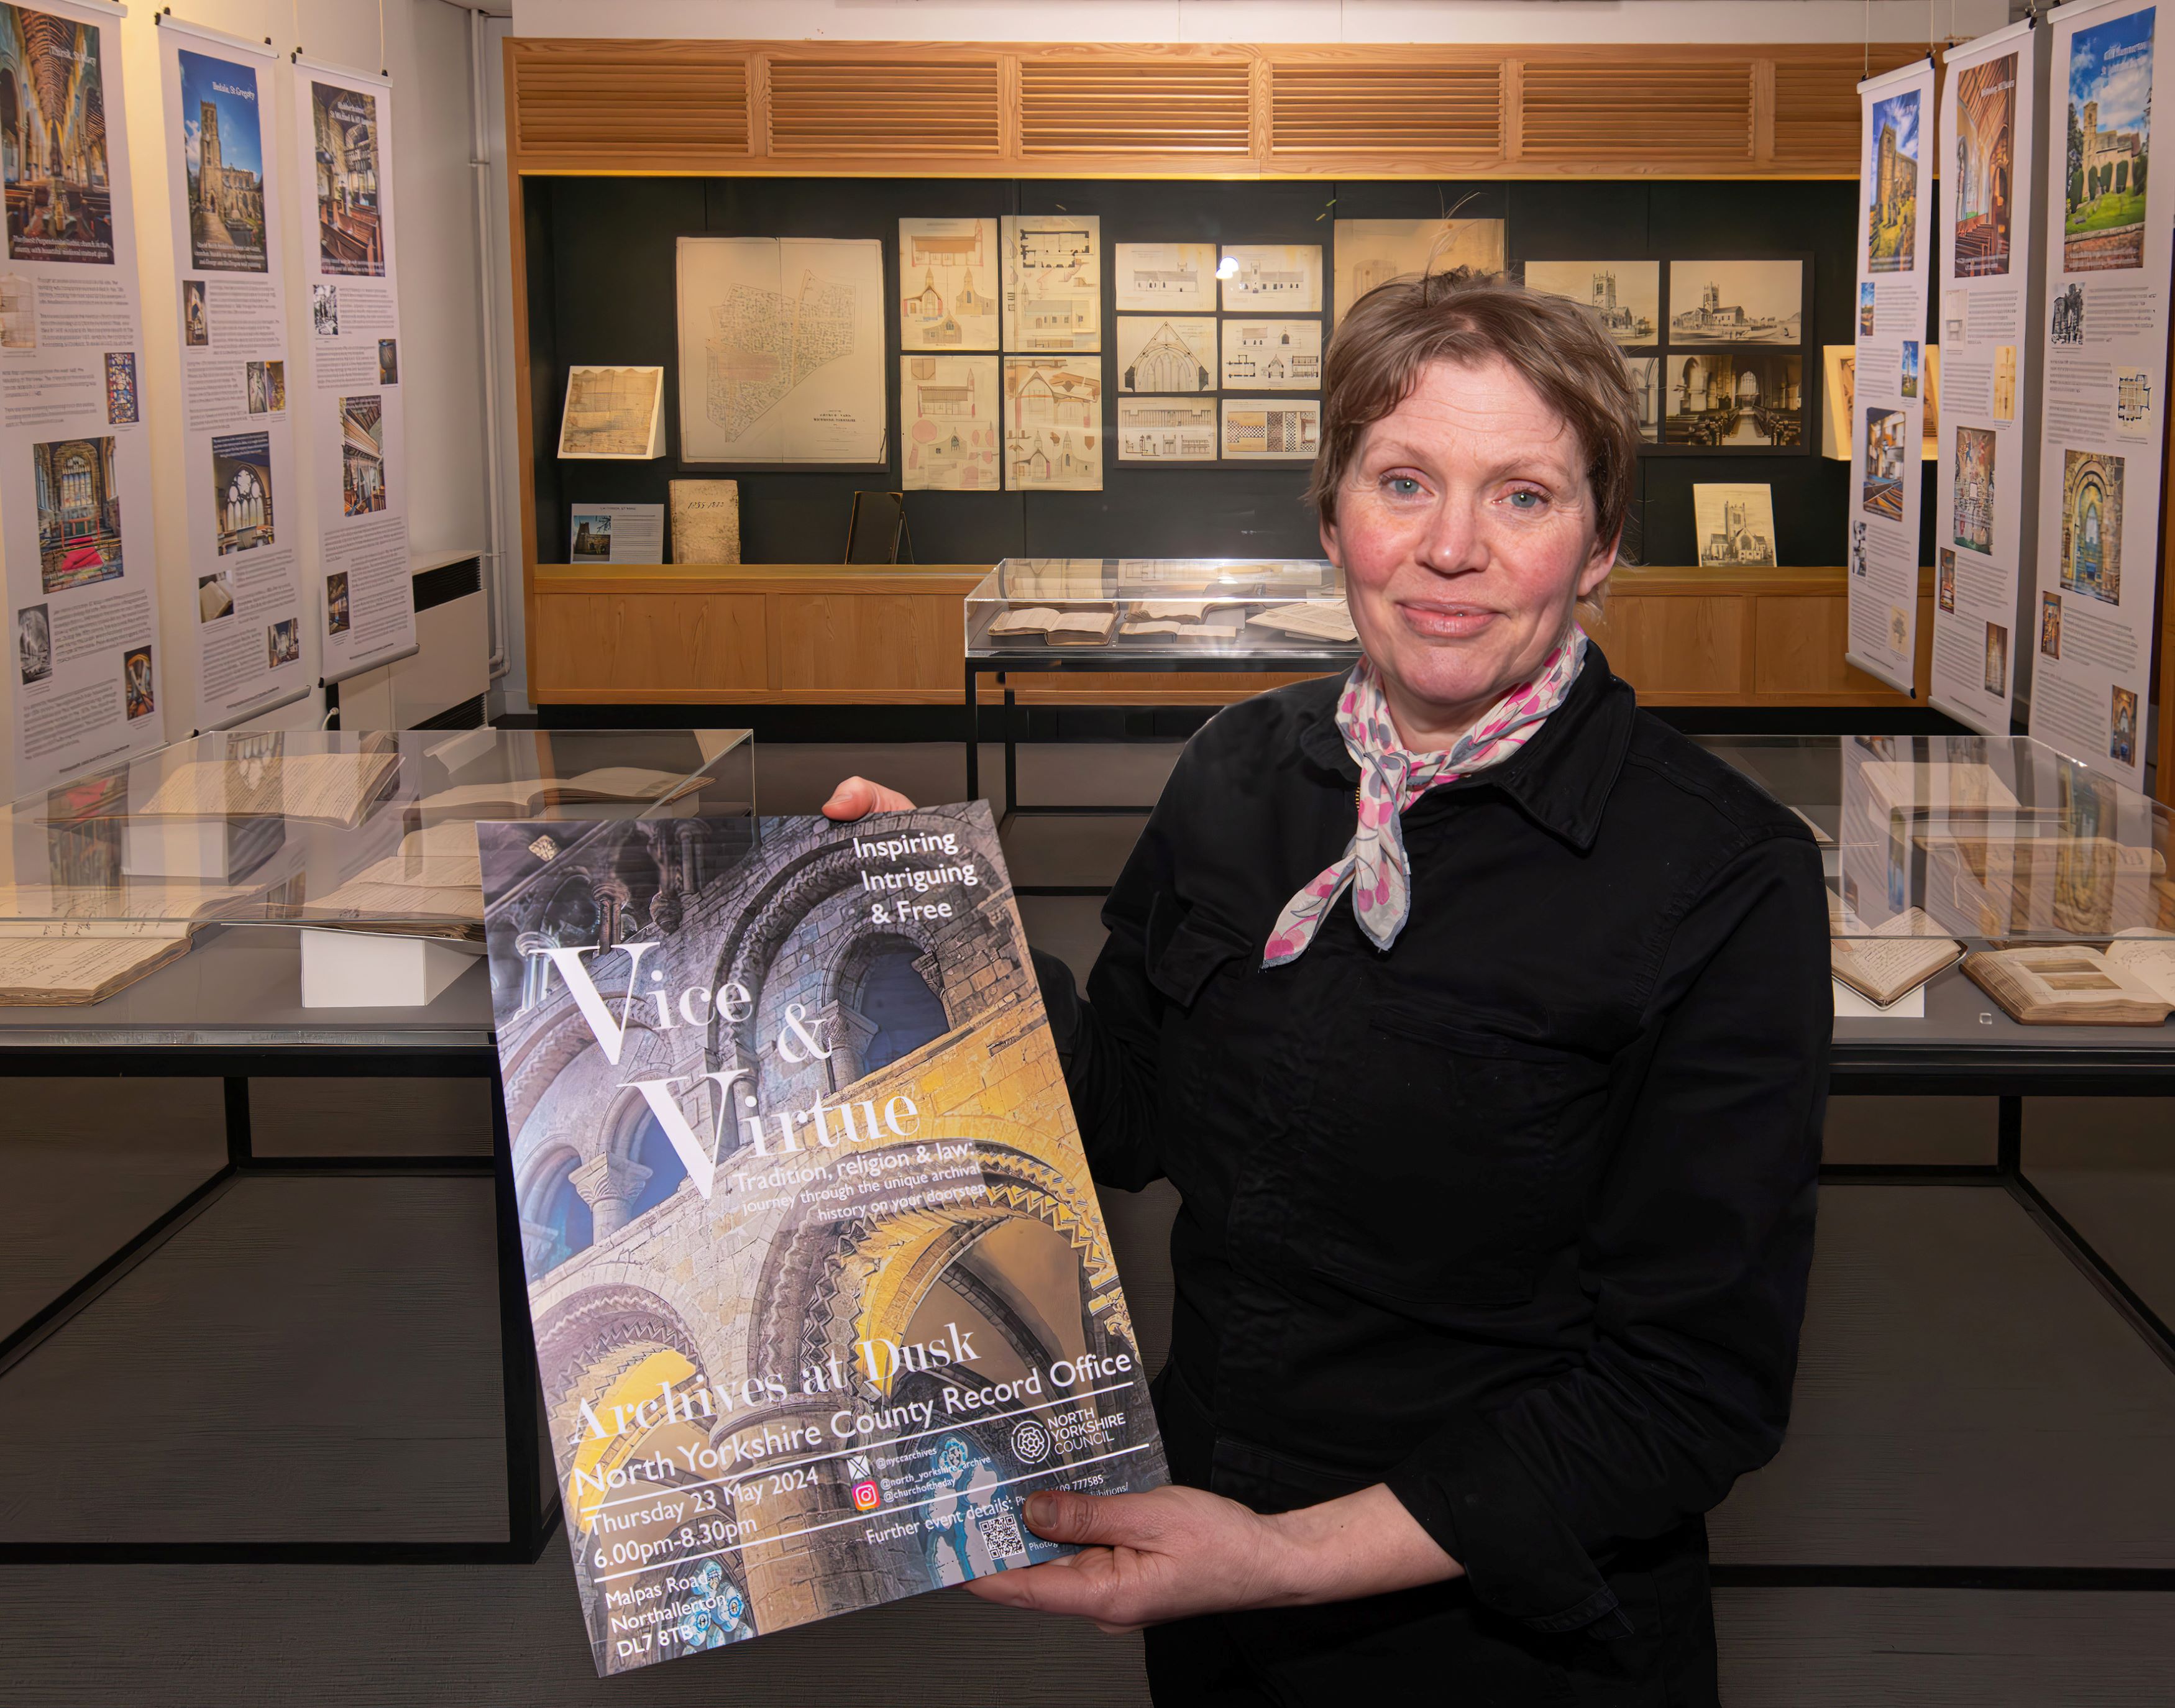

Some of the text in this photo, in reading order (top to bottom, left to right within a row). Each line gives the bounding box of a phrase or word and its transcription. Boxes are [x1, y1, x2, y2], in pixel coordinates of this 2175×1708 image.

[853, 832, 959, 862] Inspiring
[861, 863, 978, 892] Intriguing
[871, 900, 953, 925] & Free
[528, 941, 753, 1066] Vice
[777, 1002, 833, 1064] &
[615, 1068, 921, 1200] Virtue
[731, 1141, 976, 1193] Tradition, religion & law:
[742, 1161, 981, 1217] journey through the unique archival
[817, 1184, 987, 1222] history on your doorstep
[567, 1322, 982, 1445] Archives at Dusk
[573, 1352, 1132, 1497] North Yorkshire County Record Office
[1047, 1407, 1095, 1430] NORTH
[1050, 1412, 1126, 1442] YORKSHIRE
[876, 1447, 937, 1470] @nyccarchives
[1054, 1430, 1115, 1455] COUNCIL
[880, 1455, 992, 1491] @north_yorkshire_archive
[883, 1477, 956, 1503] @churchoftheday
[1072, 1474, 1104, 1491] 777585
[585, 1466, 819, 1536] Thursday 23 May 2024
[865, 1522, 920, 1545] Further
[925, 1512, 964, 1530] event
[966, 1497, 1014, 1520] details:
[593, 1517, 758, 1569] 6.00pm-8.30pm
[605, 1569, 708, 1610] Malpas Road
[610, 1594, 727, 1634] Northallerton
[616, 1625, 695, 1658] DL7 8TB
